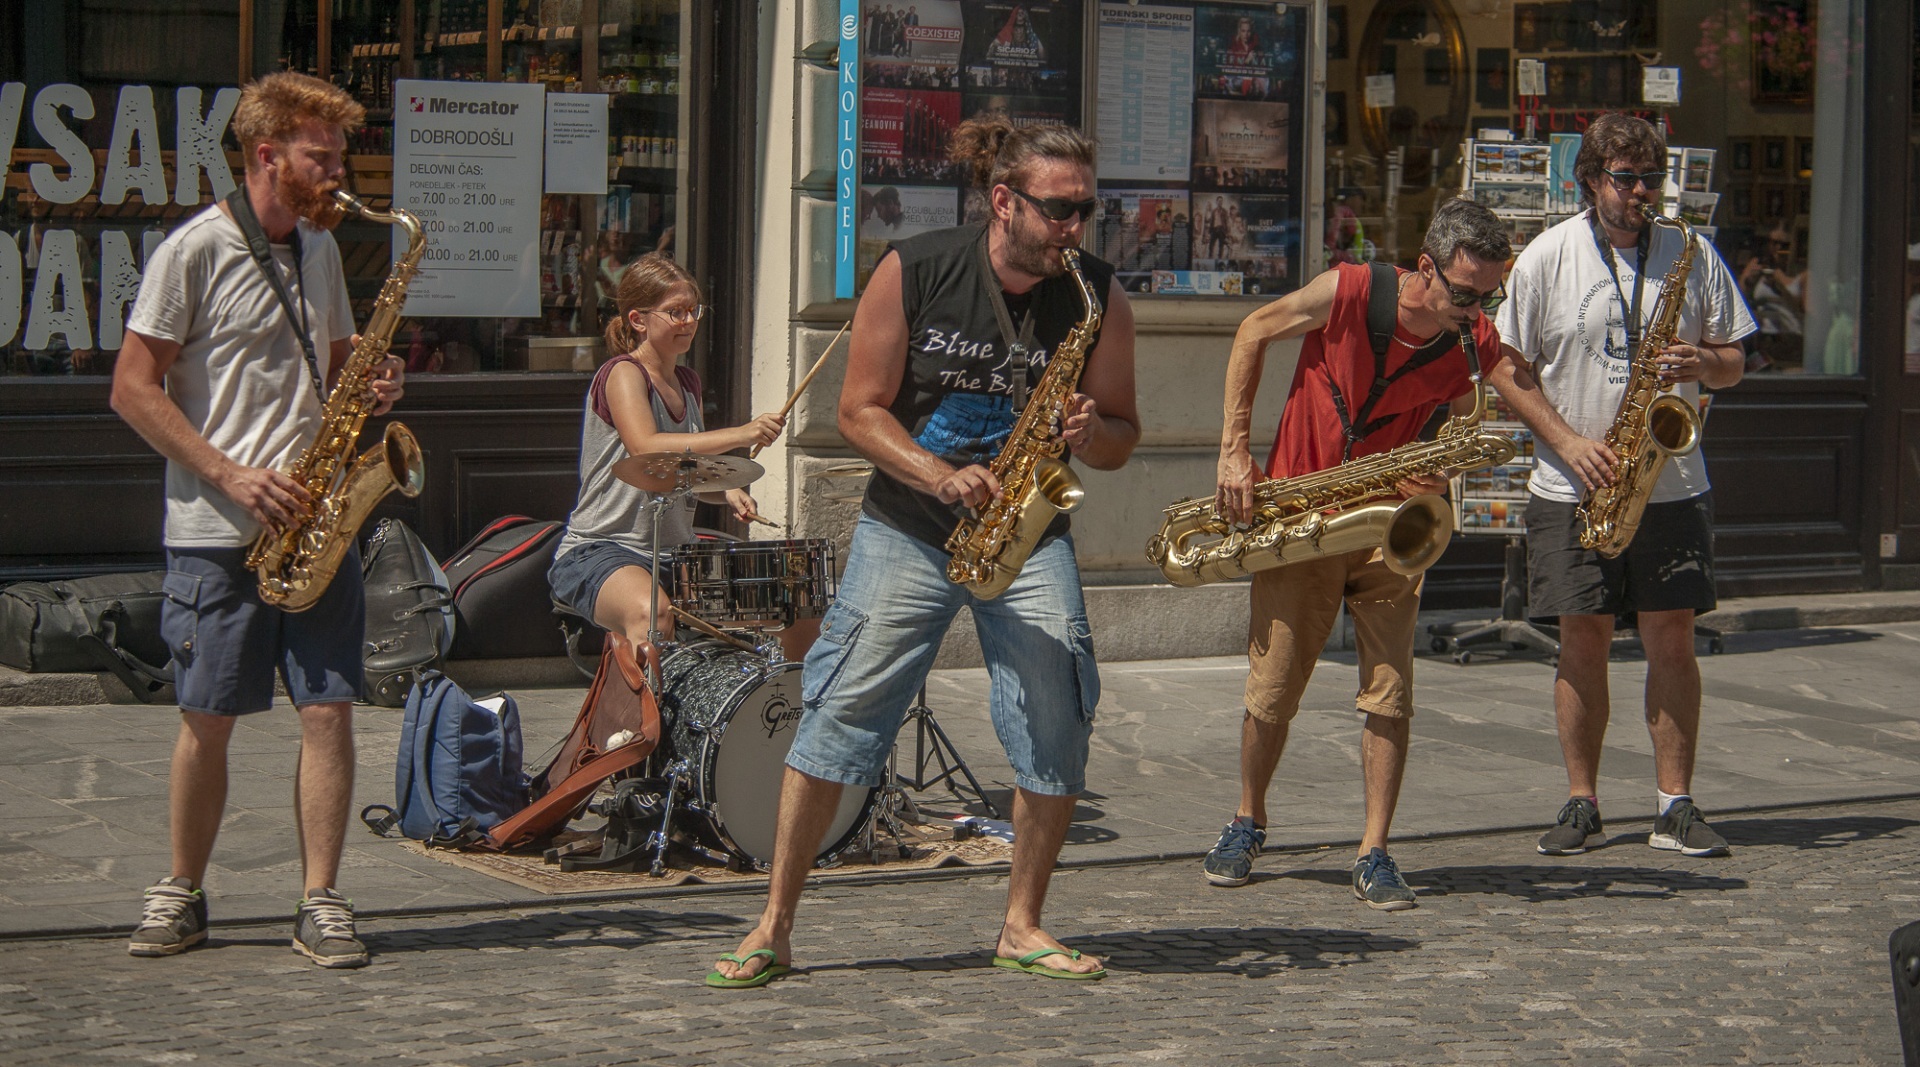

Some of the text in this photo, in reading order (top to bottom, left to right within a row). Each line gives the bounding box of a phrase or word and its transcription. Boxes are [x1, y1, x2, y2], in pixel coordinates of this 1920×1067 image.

[1152, 12, 1192, 21] SPORED
[905, 27, 960, 39] COEXISTER
[997, 46, 1029, 54] SICARIO
[429, 97, 519, 116] Mercator
[1517, 95, 1675, 135] RUSA
[410, 127, 514, 146] DOBRODOŠLI
[410, 162, 484, 176] DELOVNI ČAS:
[840, 62, 855, 263] KOLOSEJ
[409, 181, 487, 191] PONEDELJEK PETEK
[409, 192, 516, 206] OD 7.00 DO 21.00 URE
[903, 206, 955, 215] IZGUBLJENA
[463, 221, 494, 234] 21.00
[468, 249, 499, 262] 21.00
[1578, 277, 1614, 321] INTERNATIONA
[1577, 322, 1586, 336] VIS
[923, 328, 994, 359] Blue
[940, 370, 982, 390] The
